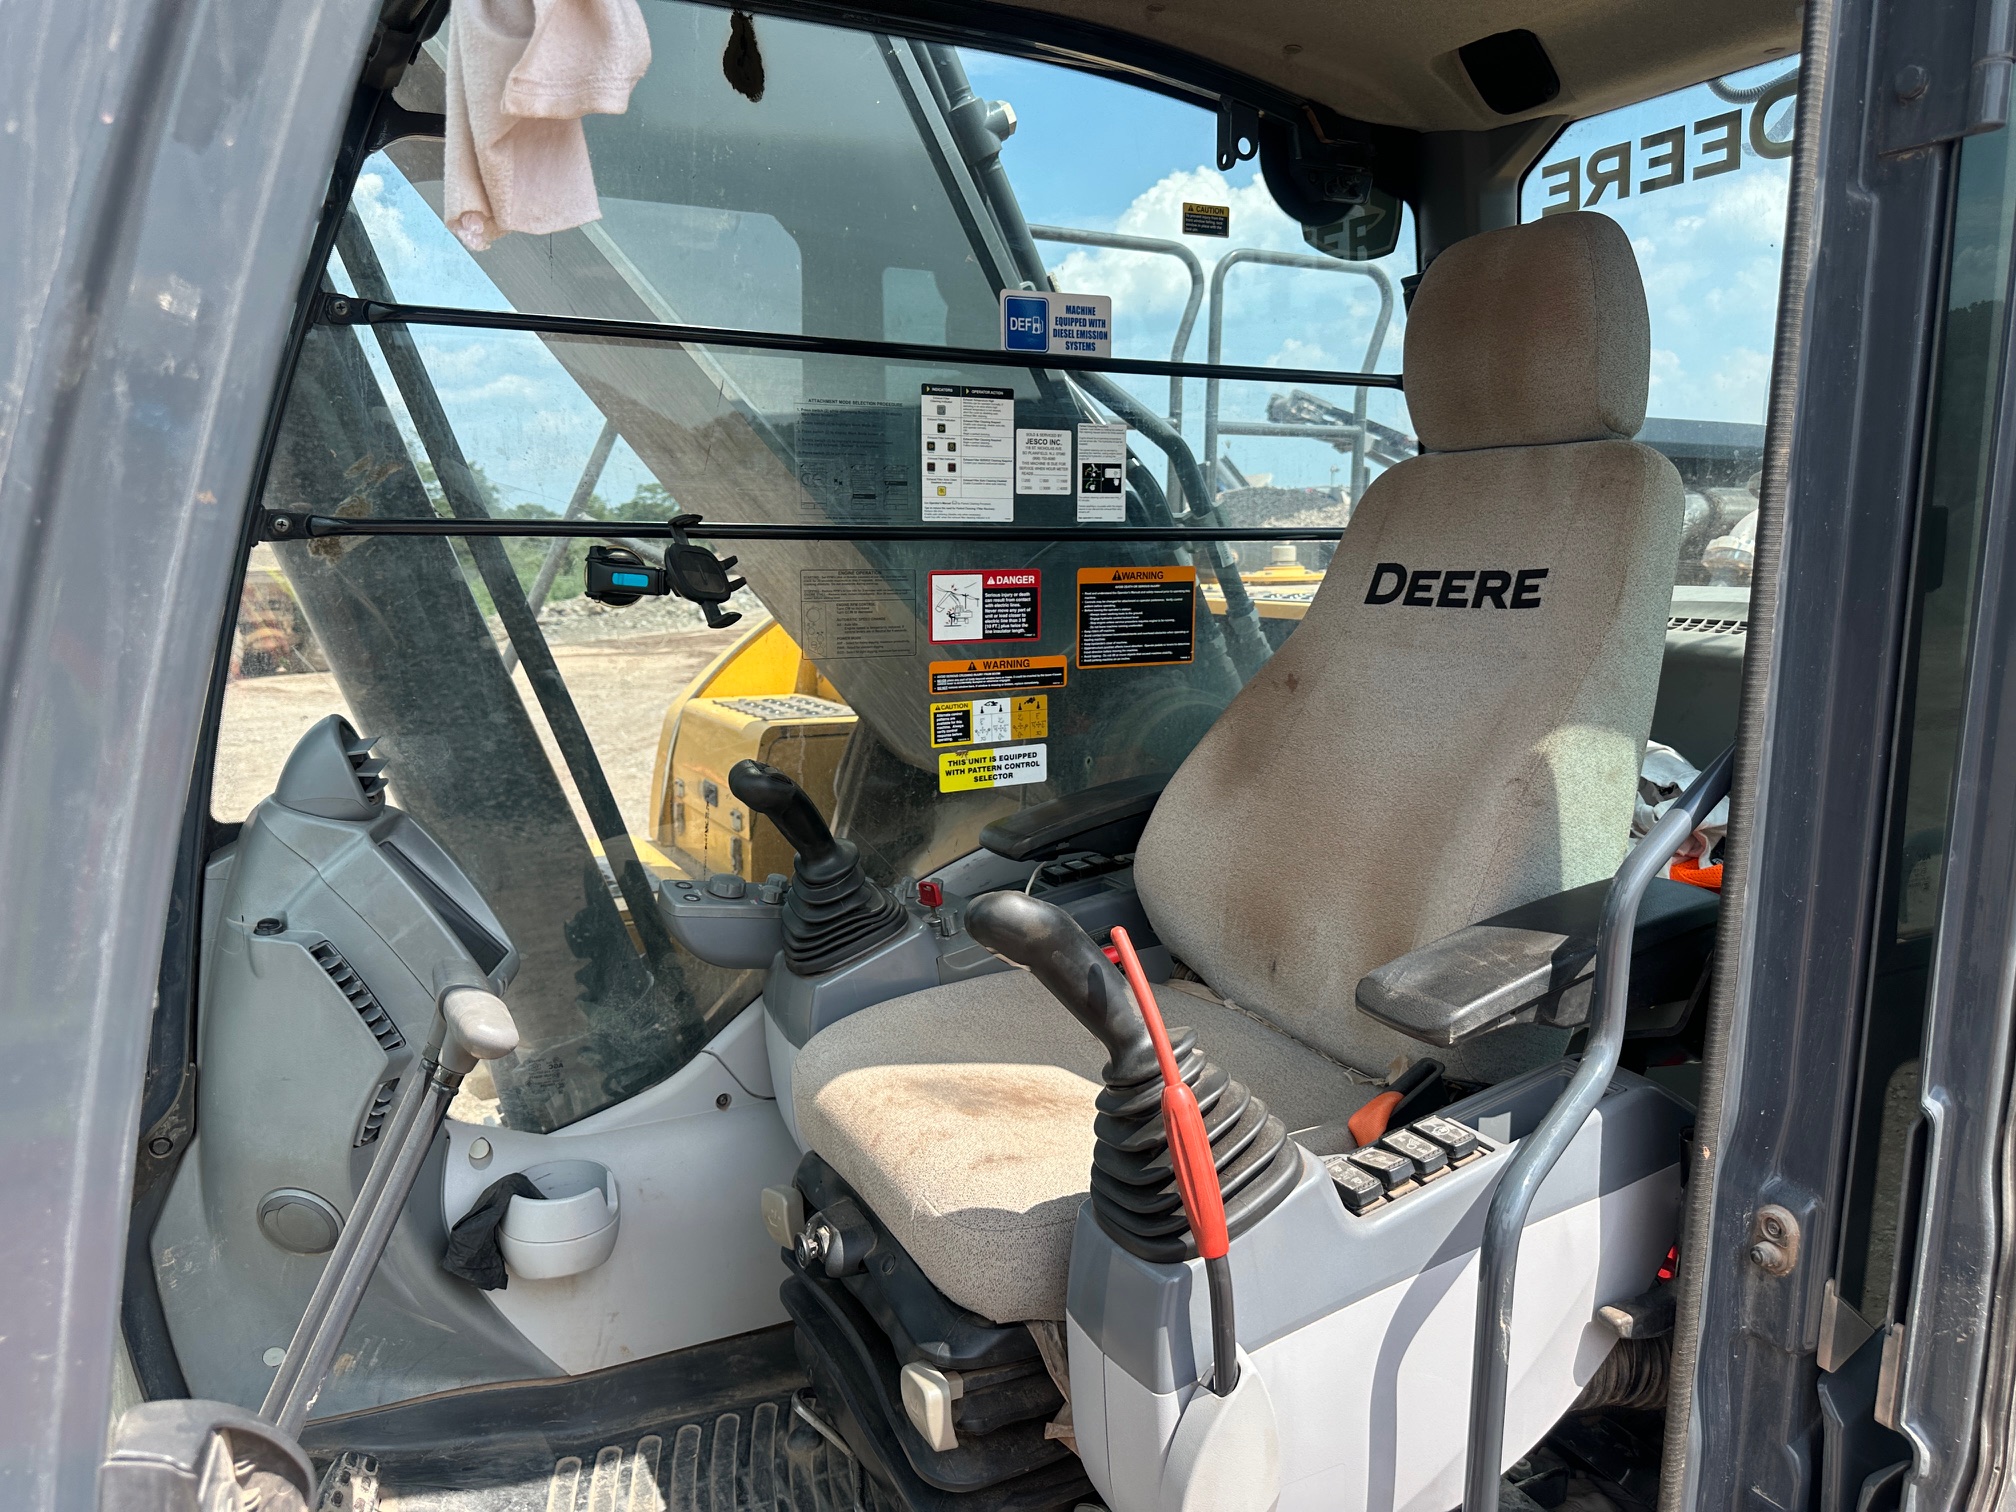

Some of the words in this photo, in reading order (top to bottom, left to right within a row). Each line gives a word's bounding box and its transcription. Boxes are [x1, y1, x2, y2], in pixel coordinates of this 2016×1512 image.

[1196, 205, 1224, 215] CAUTION
[1066, 305, 1096, 316] MACHINE
[1010, 317, 1031, 331] DEF
[1055, 316, 1087, 328] EQUIPPED
[1088, 318, 1106, 328] WITH
[1053, 328, 1075, 338] DIESEL
[1076, 329, 1108, 340] EMISSION
[1065, 341, 1096, 351] SYSTEMS
[996, 575, 1035, 585] DANGER
[1122, 570, 1164, 580] WARNING
[1364, 562, 1549, 609] DEERE
[983, 659, 1030, 669] WARNING
[999, 752, 1037, 761] EQUIPPED
[968, 765, 1002, 774] PATTERN
[1004, 760, 1040, 770] CONTROL
[974, 773, 1013, 782] SELECTOR
